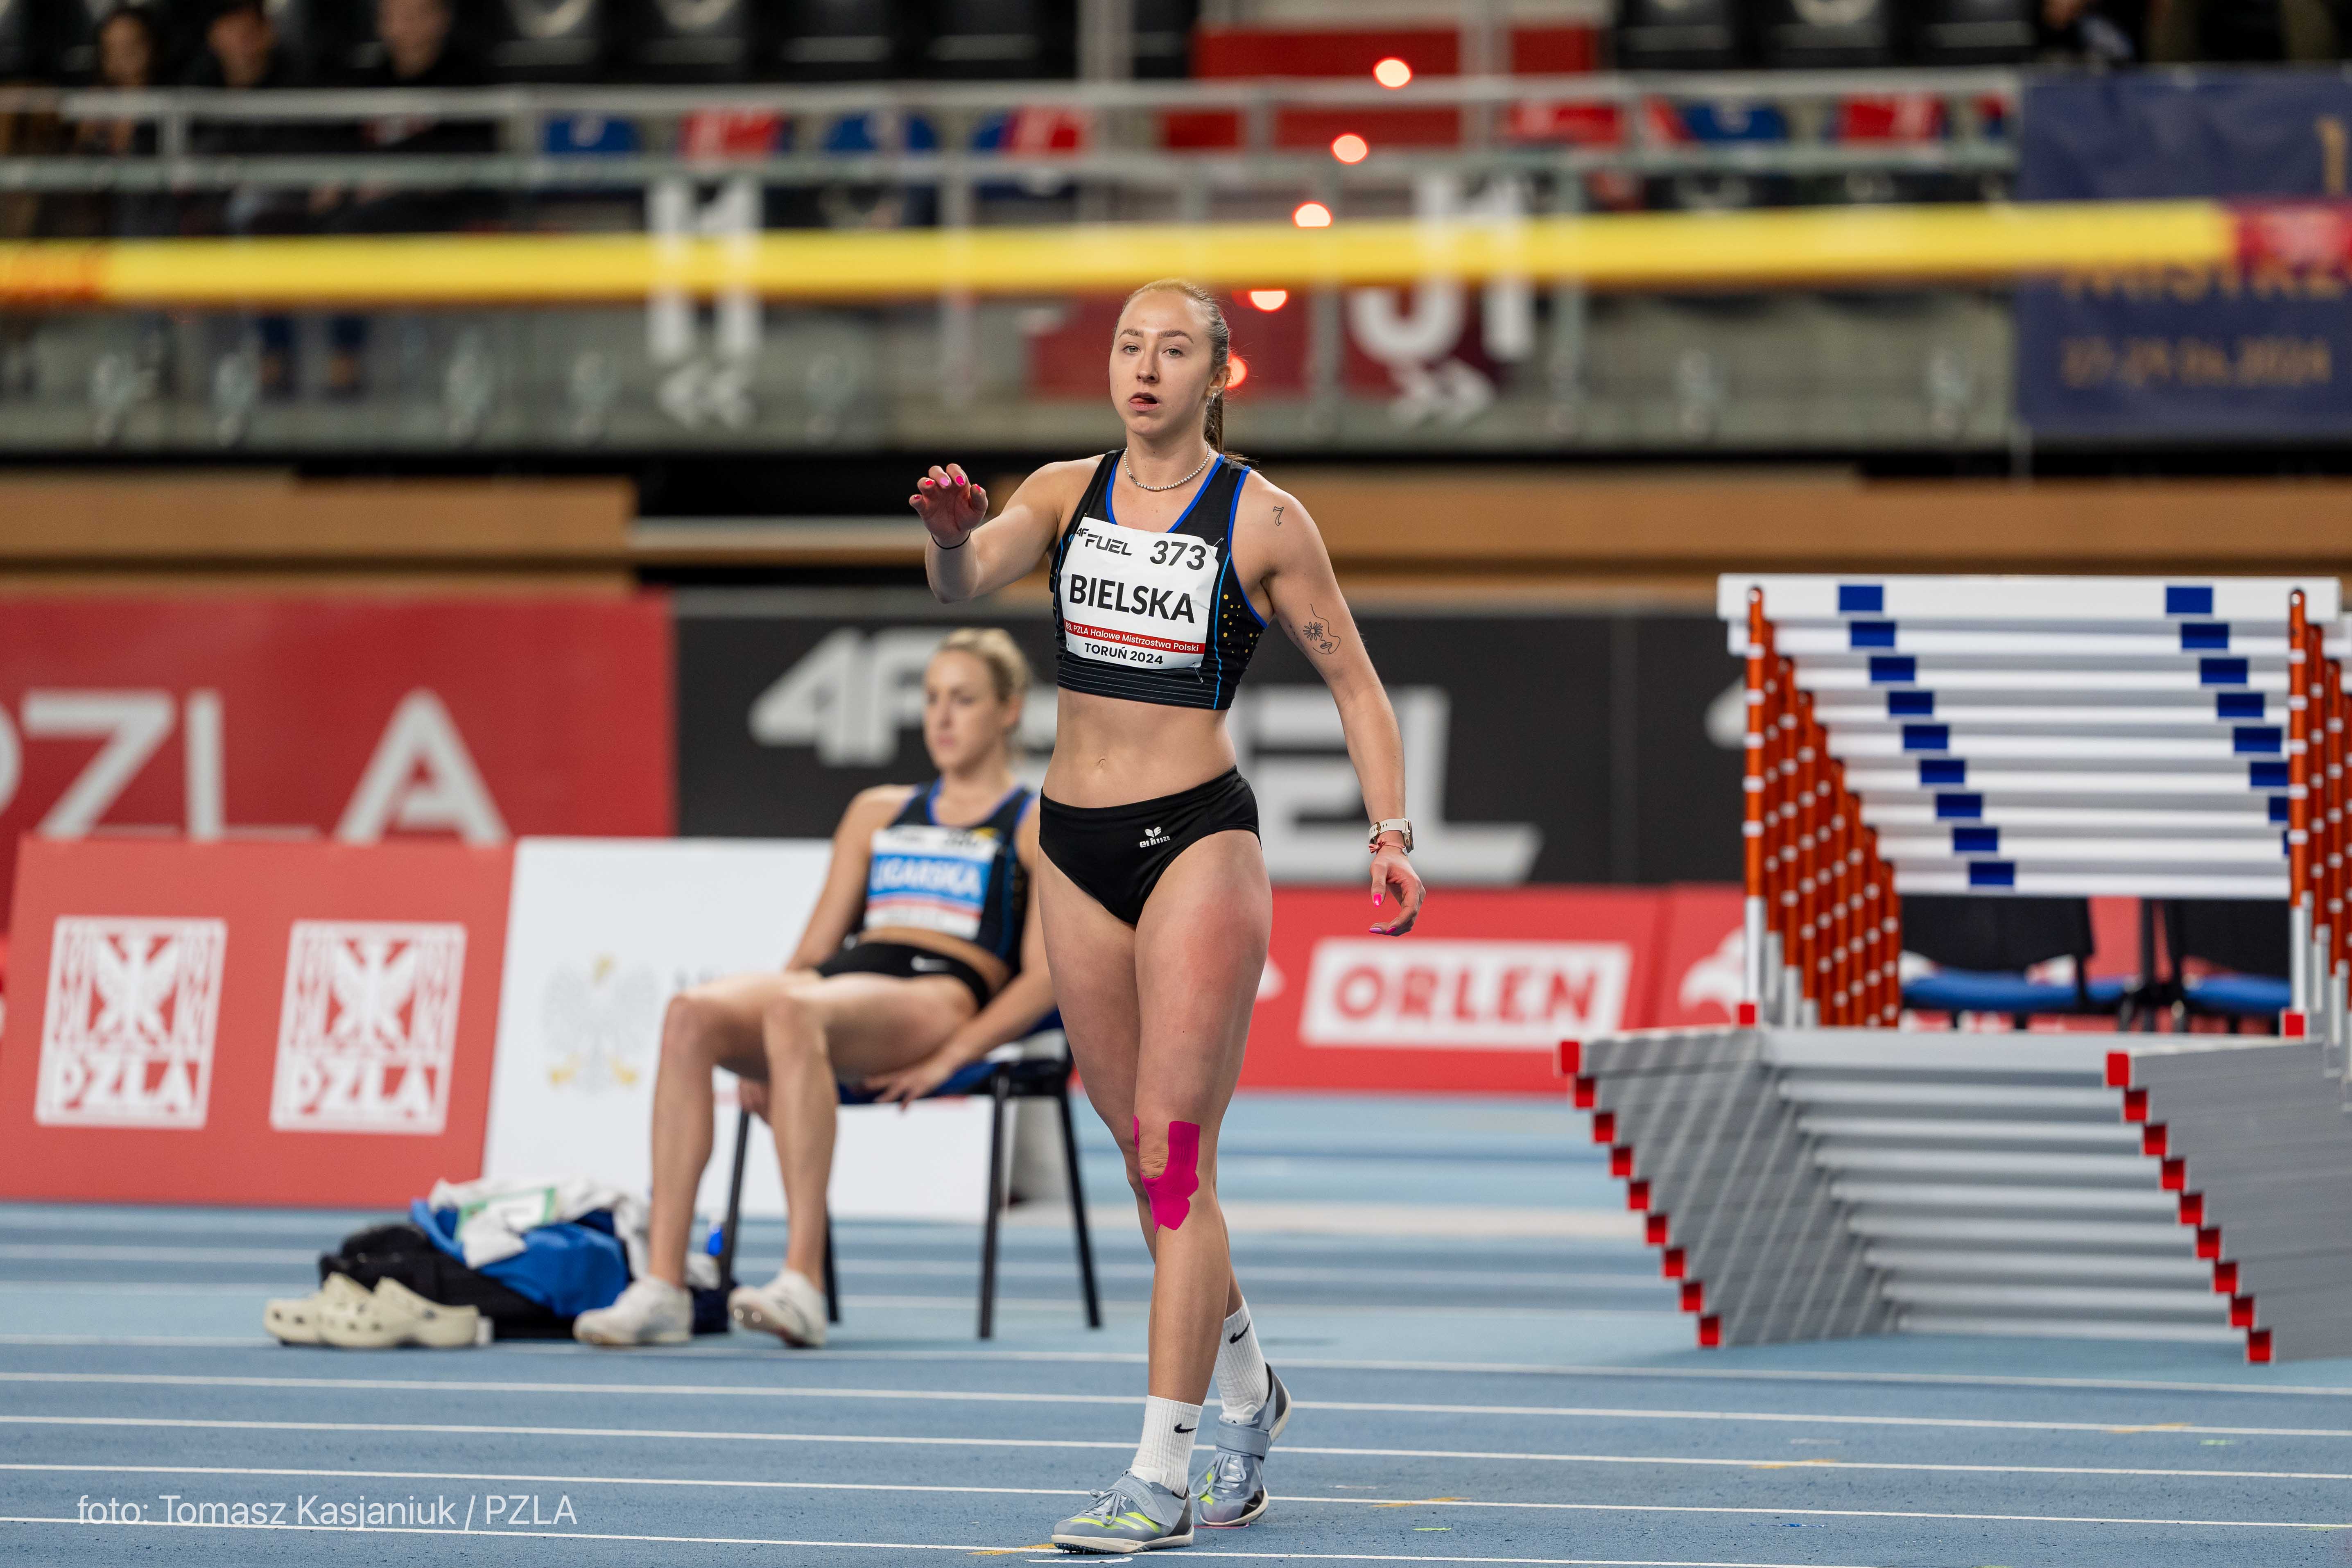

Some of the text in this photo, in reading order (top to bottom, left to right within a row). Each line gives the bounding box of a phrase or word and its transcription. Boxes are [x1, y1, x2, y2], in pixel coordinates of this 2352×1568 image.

[1272, 506, 1285, 527] 7
[1085, 533, 1133, 556] FUEL
[1150, 540, 1207, 570] 373
[1069, 574, 1195, 624] BIELSKA
[1073, 625, 1088, 635] PZLA
[1090, 629, 1120, 640] Halowe
[1122, 634, 1171, 649] Mistrzostwa
[1173, 643, 1199, 652] Polski
[1085, 643, 1163, 665] TORUŃ 2024
[1140, 836, 1170, 848] erima
[1334, 964, 1597, 1024] ORLEN
[46, 1056, 200, 1115] PZLA
[283, 1060, 438, 1119] PZLA
